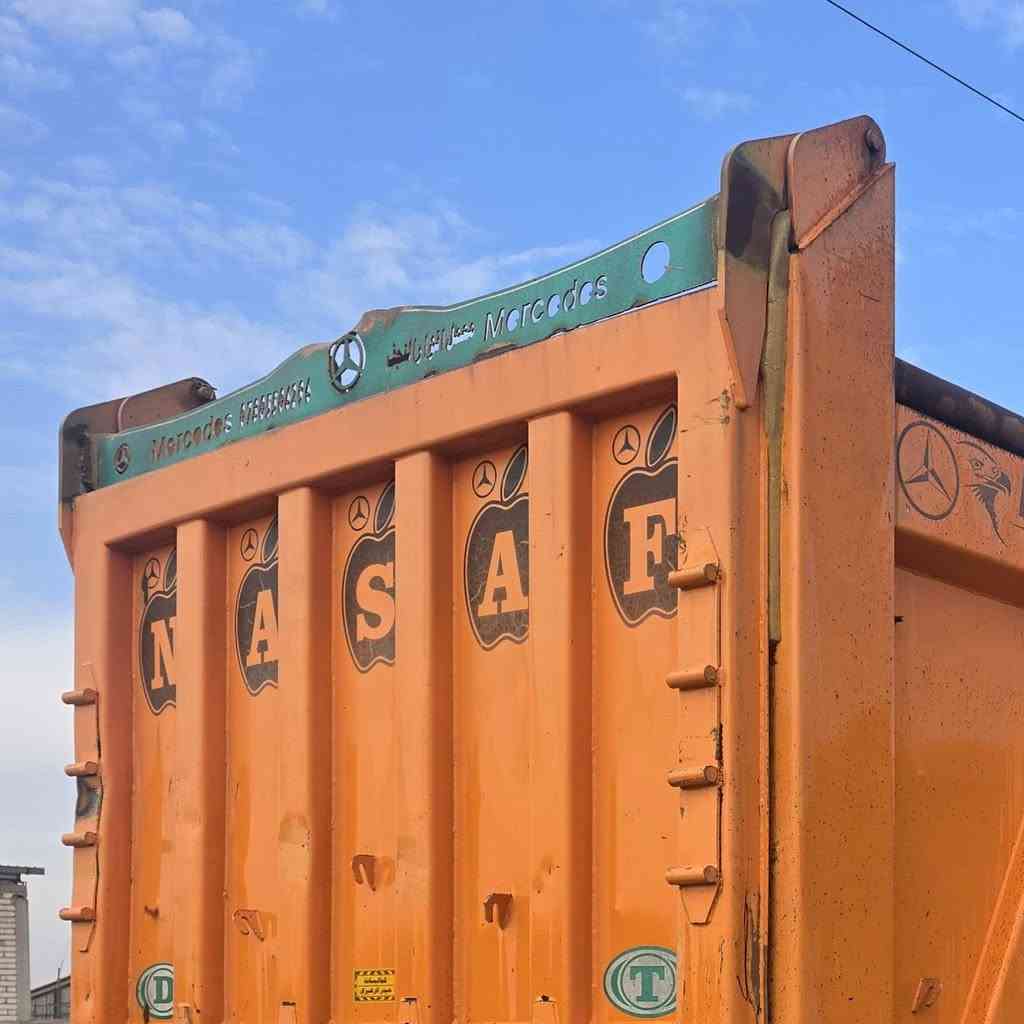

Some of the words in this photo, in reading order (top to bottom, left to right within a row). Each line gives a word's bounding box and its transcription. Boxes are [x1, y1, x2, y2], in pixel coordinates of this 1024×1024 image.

[484, 274, 608, 342] Mercedes
[151, 412, 233, 464] Mercedes
[153, 976, 174, 1004] D
[630, 966, 665, 1001] T
